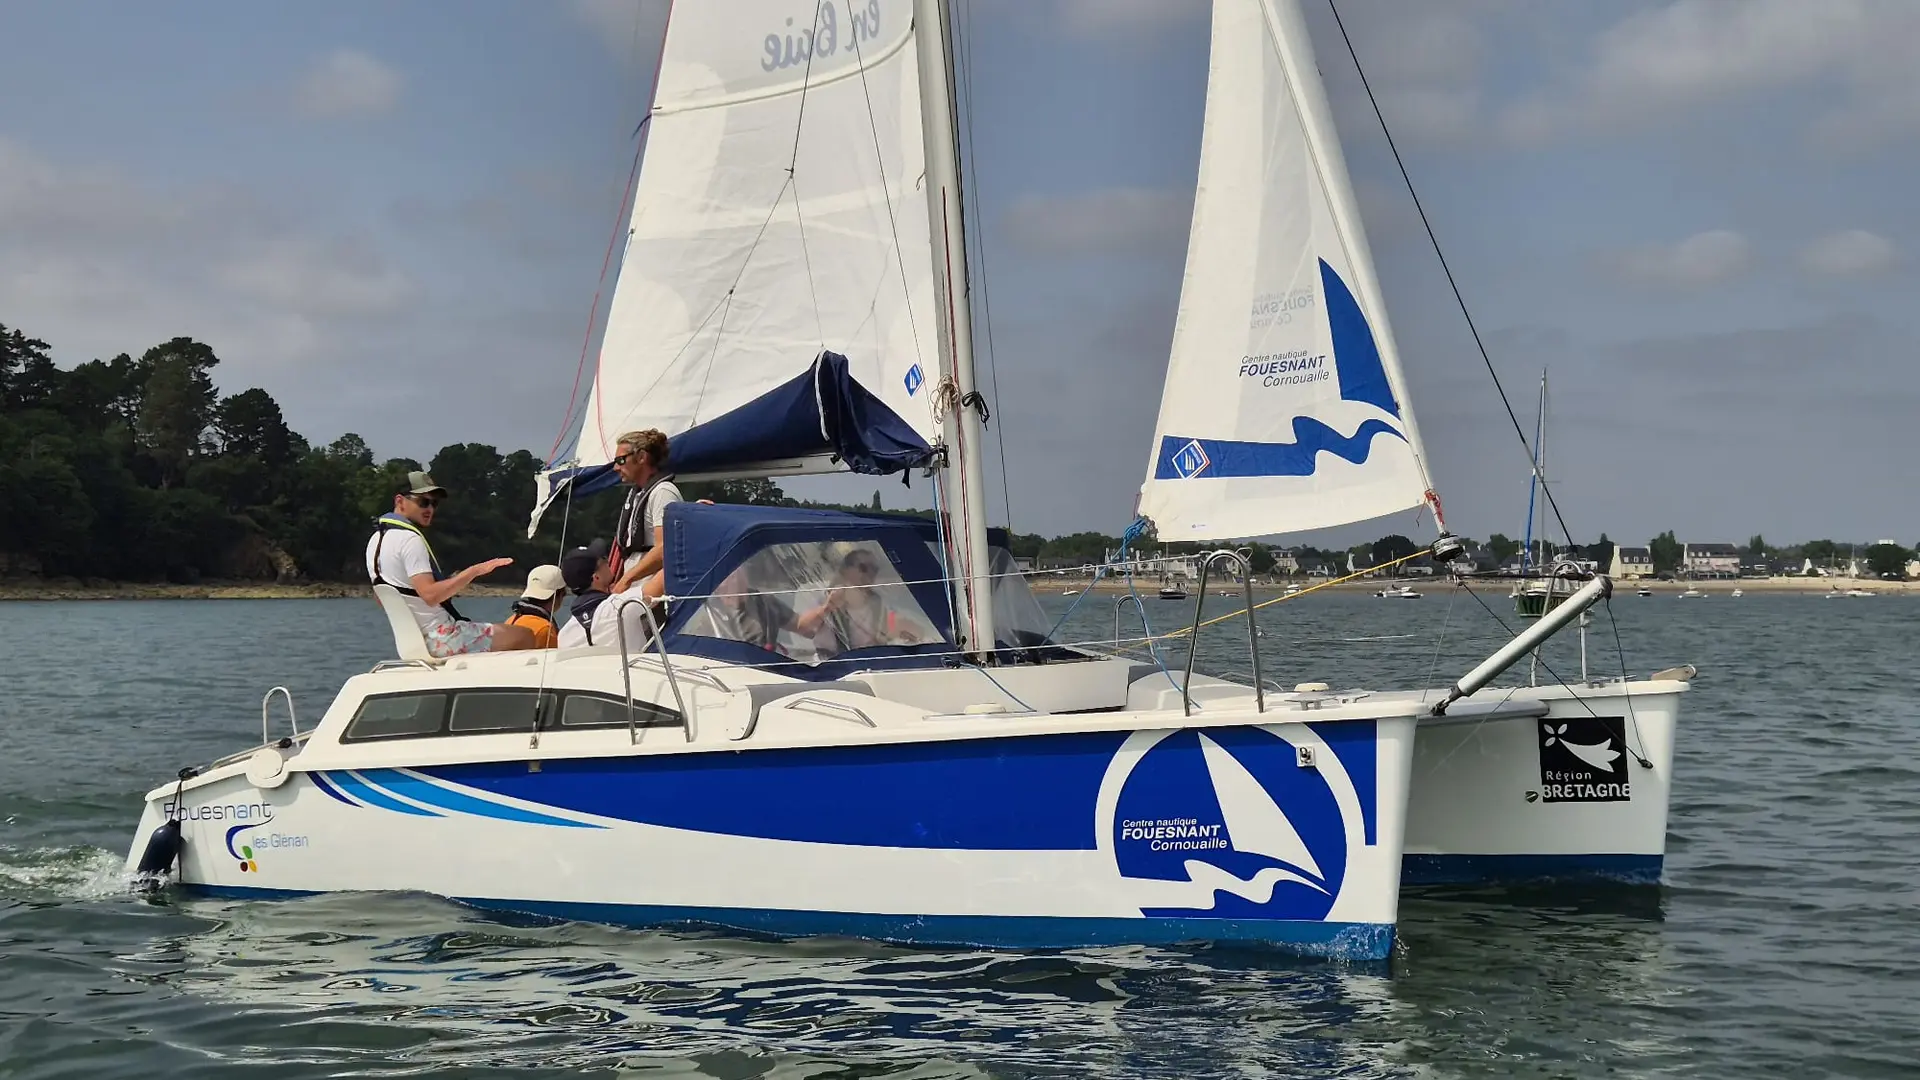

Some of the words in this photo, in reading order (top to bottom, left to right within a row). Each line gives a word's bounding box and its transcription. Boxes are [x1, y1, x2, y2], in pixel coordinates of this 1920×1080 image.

[1241, 354, 1270, 365] Centre
[1272, 350, 1308, 362] nautique
[1239, 355, 1326, 377] FOUESNANT
[1263, 369, 1330, 387] Cornouaille
[1546, 771, 1592, 782] Région
[1542, 783, 1630, 798] BRETAGNE
[163, 803, 272, 821] Fouesnant
[1122, 819, 1154, 828] Centre
[1156, 817, 1197, 828] nautique
[1122, 824, 1221, 840] FOUESNANT
[252, 836, 268, 849] les
[270, 833, 309, 849] Glénan
[1150, 838, 1228, 851] Cornouaille
